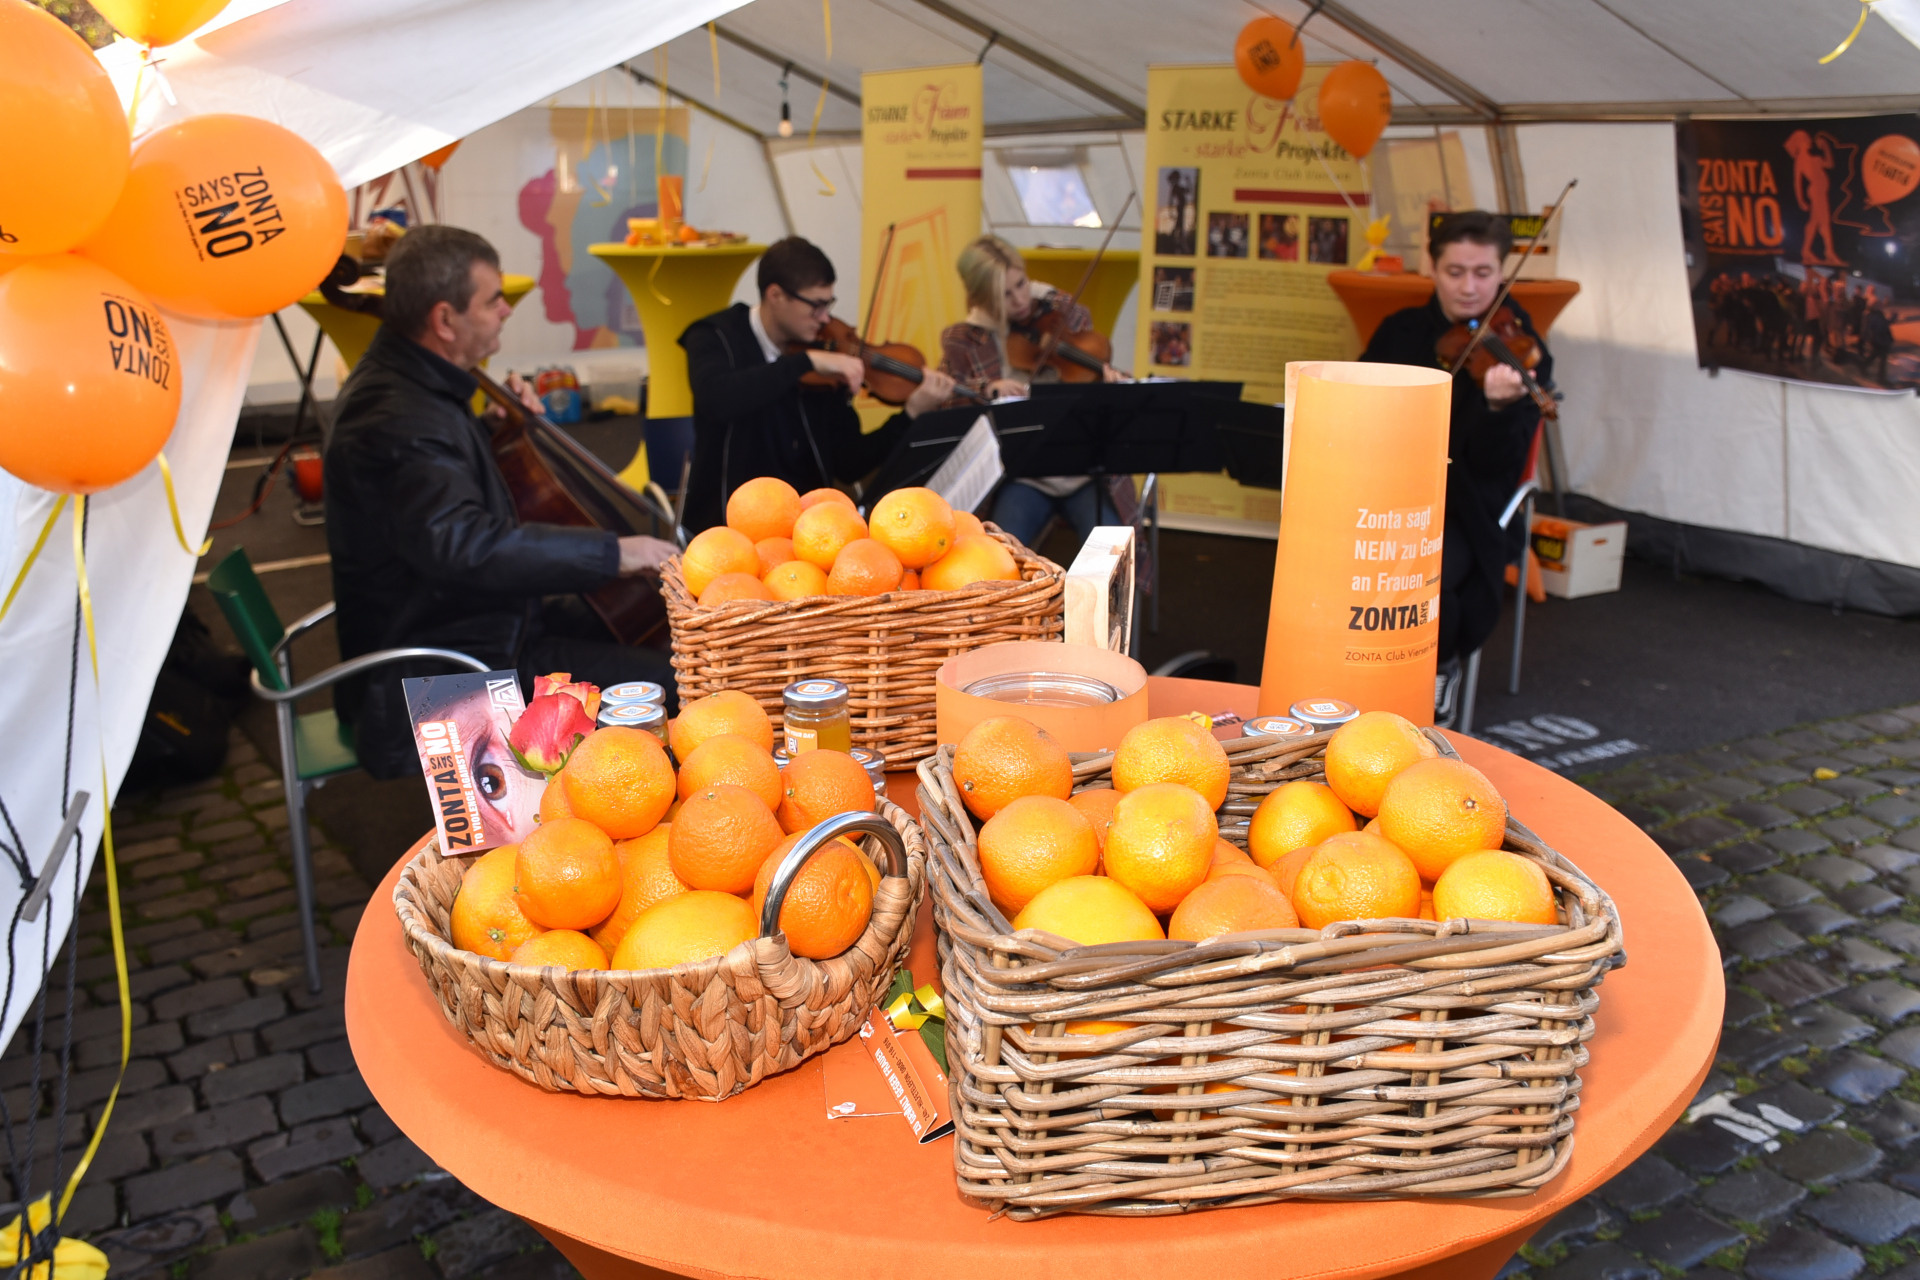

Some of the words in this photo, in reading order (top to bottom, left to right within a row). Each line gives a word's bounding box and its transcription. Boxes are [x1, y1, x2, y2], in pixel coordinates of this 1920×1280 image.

[1160, 110, 1238, 132] STARKE
[184, 176, 235, 208] SAYS
[1697, 158, 1778, 195] ZONTA
[234, 165, 286, 246] ZONTA
[1700, 195, 1726, 246] SAYS
[193, 201, 254, 259] NO
[1726, 196, 1784, 247] NO
[104, 300, 153, 348] NO
[109, 340, 170, 391] ZONTA
[1356, 508, 1402, 529] Zonta
[1406, 506, 1431, 531] sagt
[1354, 539, 1397, 561] NEIN
[1400, 543, 1417, 560] zu
[1351, 575, 1371, 592] an
[1377, 572, 1423, 592] Frauen
[1348, 604, 1419, 631] ZONTA
[1420, 600, 1429, 626] SAYS
[1345, 651, 1382, 662] ZONTA
[1385, 649, 1406, 661] Club
[420, 722, 452, 756] NO
[447, 721, 464, 751] WOMEN
[429, 755, 454, 770] SAYS
[455, 753, 472, 789] AGAINST
[434, 769, 473, 849] ZONTA
[465, 790, 482, 831] VIOLENCE
[474, 833, 485, 845] TO
[875, 1048, 893, 1077] FRAUEN
[888, 1073, 904, 1098] GEGEN
[899, 1095, 917, 1125] GEWALT
[913, 1121, 922, 1136] ZU
